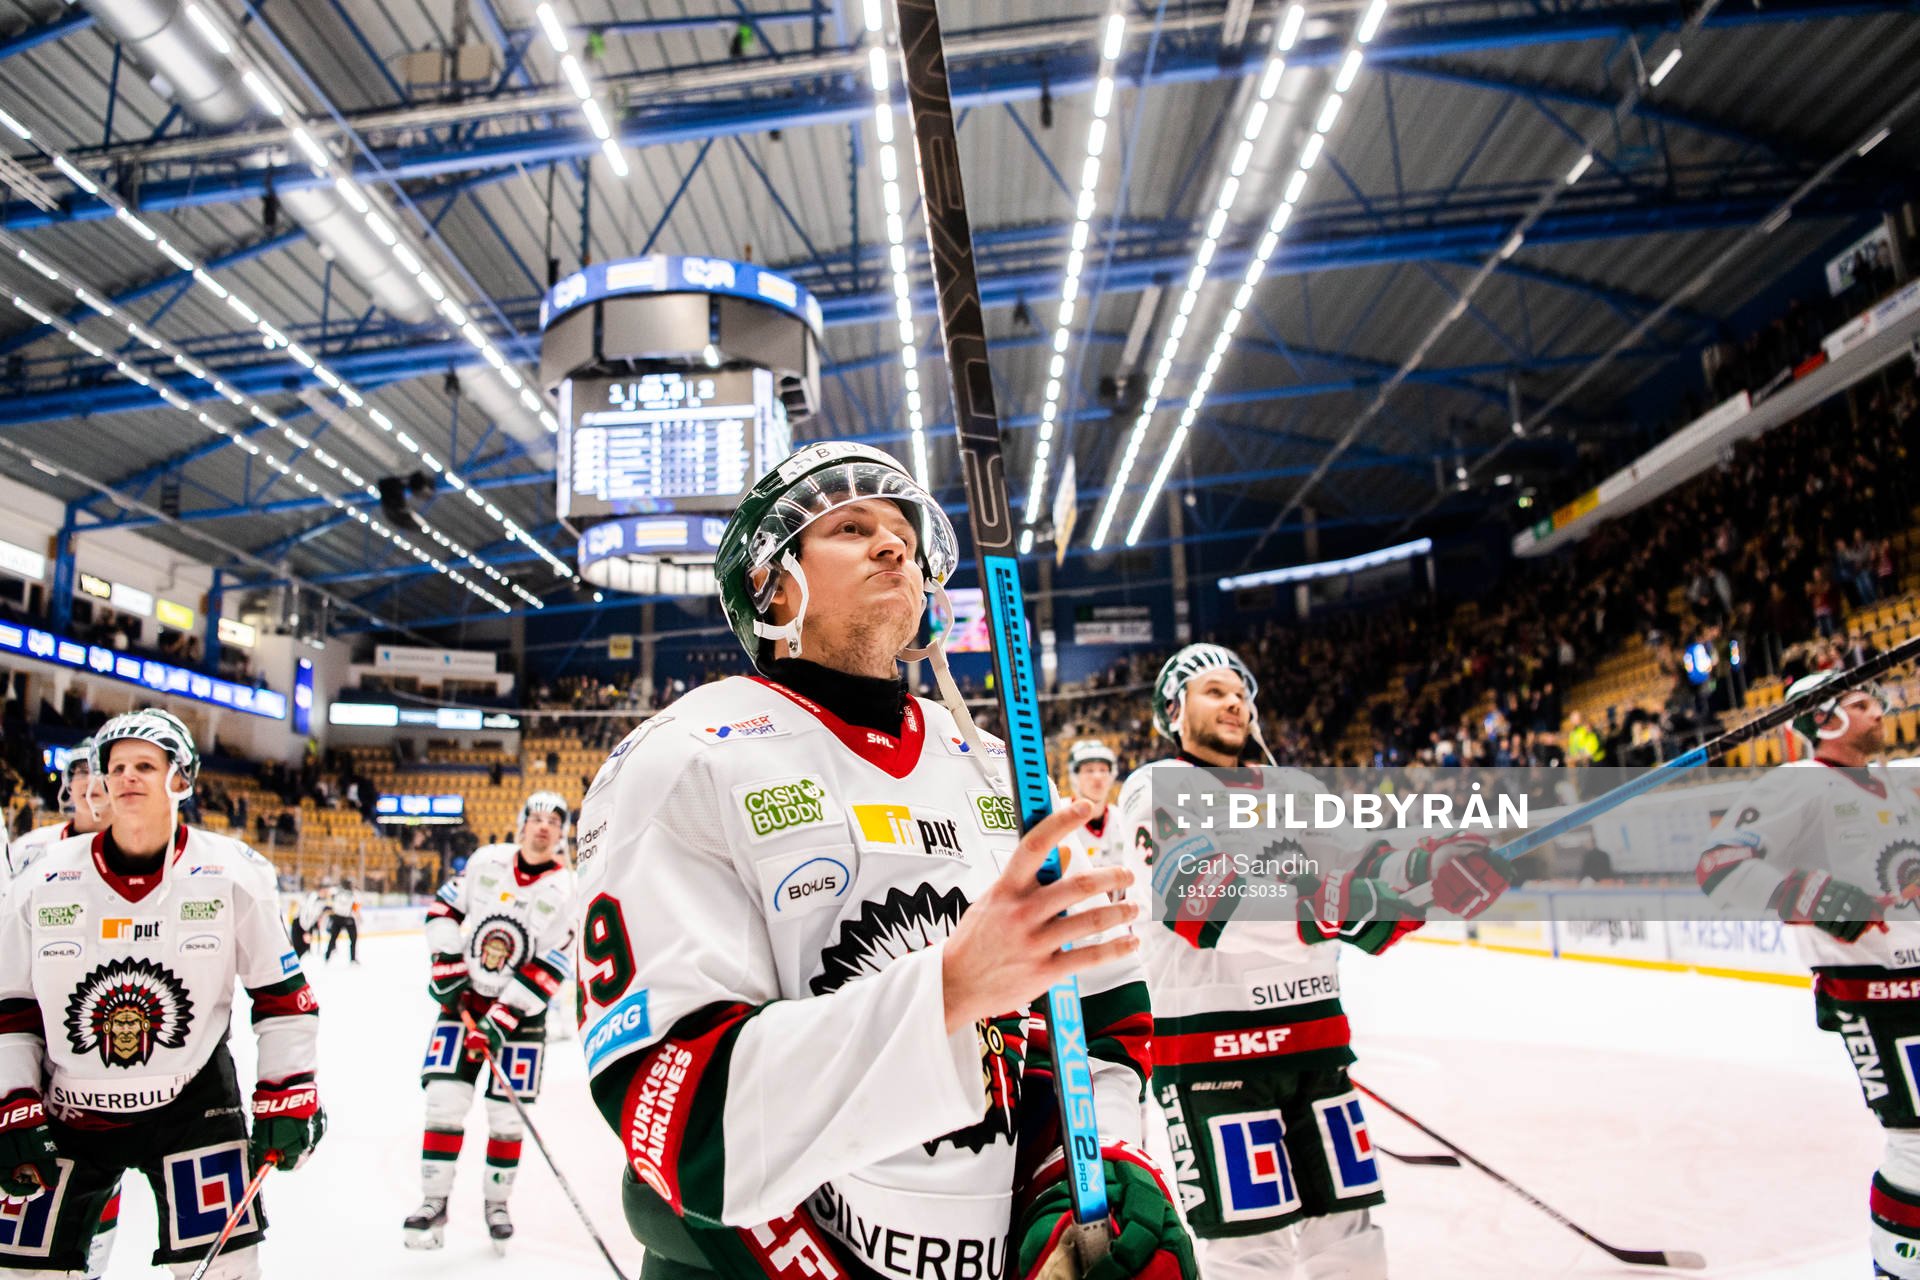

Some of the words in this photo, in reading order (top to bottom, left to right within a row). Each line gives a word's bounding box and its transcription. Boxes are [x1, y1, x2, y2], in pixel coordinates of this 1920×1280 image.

[866, 732, 894, 748] SHL
[745, 786, 801, 813] CASH
[752, 801, 823, 836] BUDDY
[787, 876, 836, 900] BOHUS
[1213, 1028, 1291, 1058] SKF
[632, 1043, 678, 1152] TURKISH
[647, 1048, 693, 1167] AIRLINES
